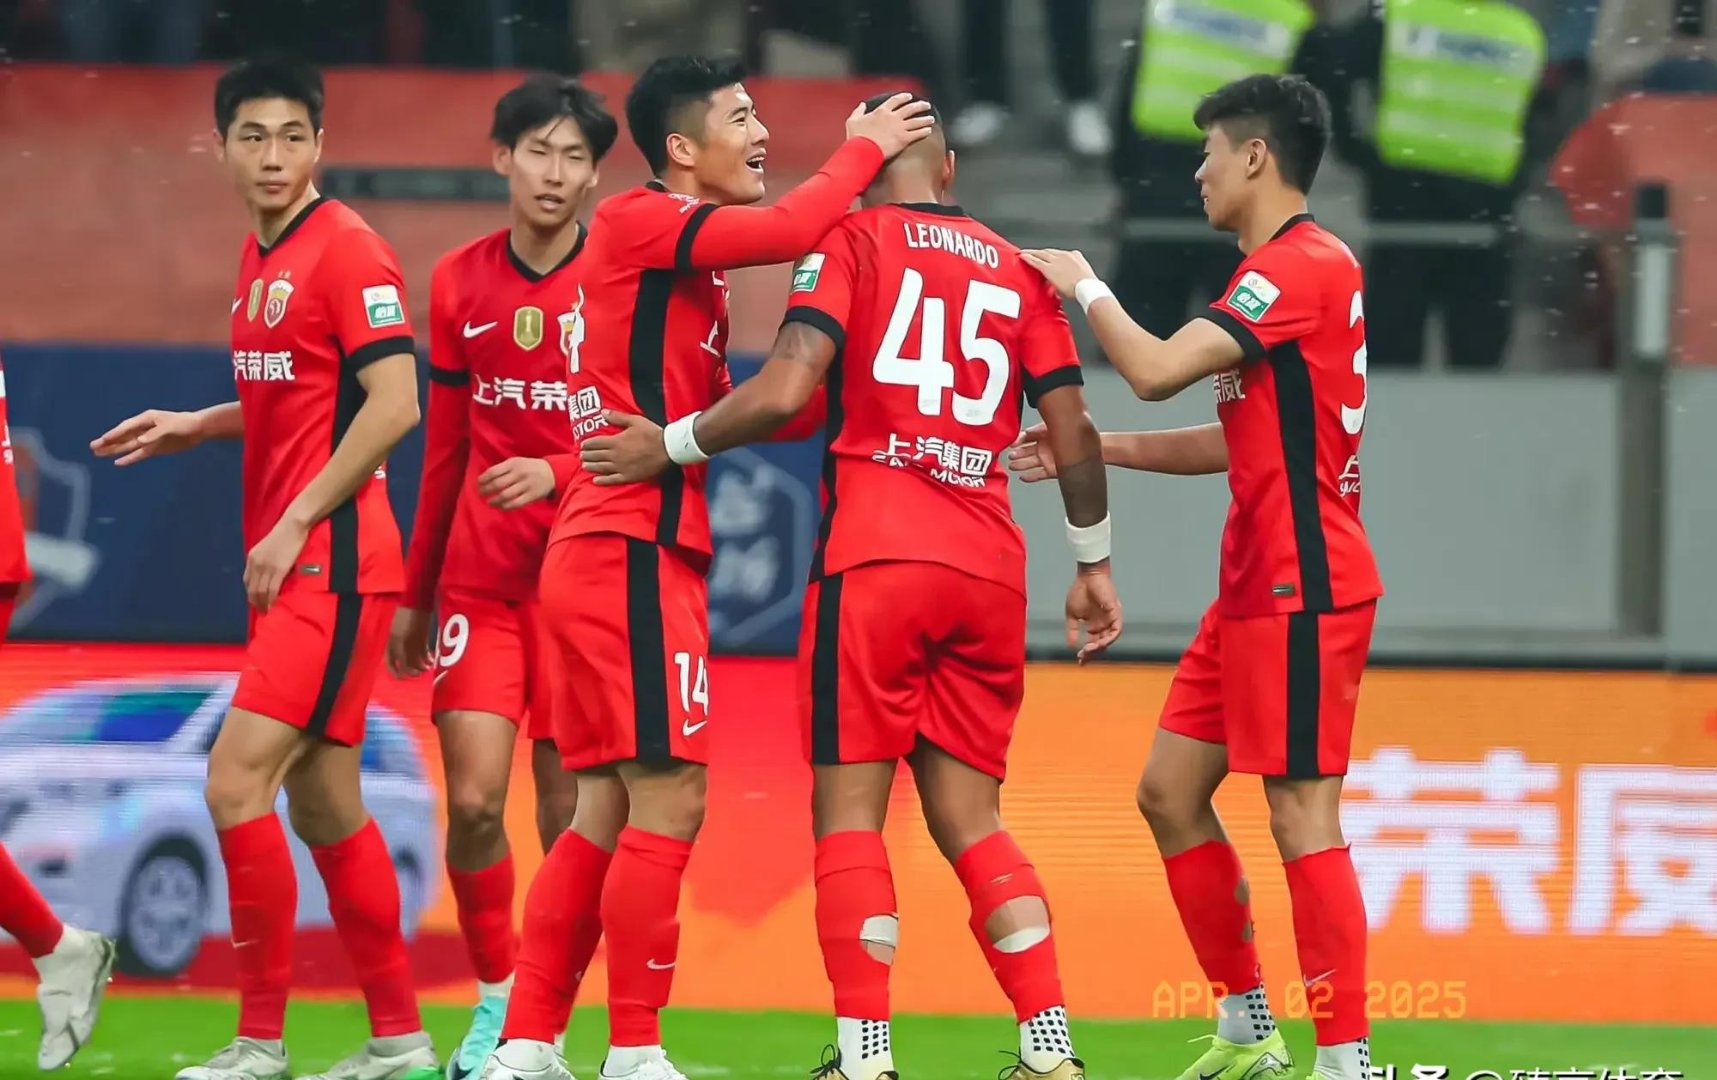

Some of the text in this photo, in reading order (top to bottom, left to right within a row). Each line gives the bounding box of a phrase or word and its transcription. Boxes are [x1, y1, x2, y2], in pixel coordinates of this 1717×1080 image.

[903, 222, 999, 269] LEONARDO
[872, 267, 1021, 426] 45
[872, 433, 993, 477] 上汽集团
[434, 613, 470, 668] 9
[674, 652, 709, 717] 14
